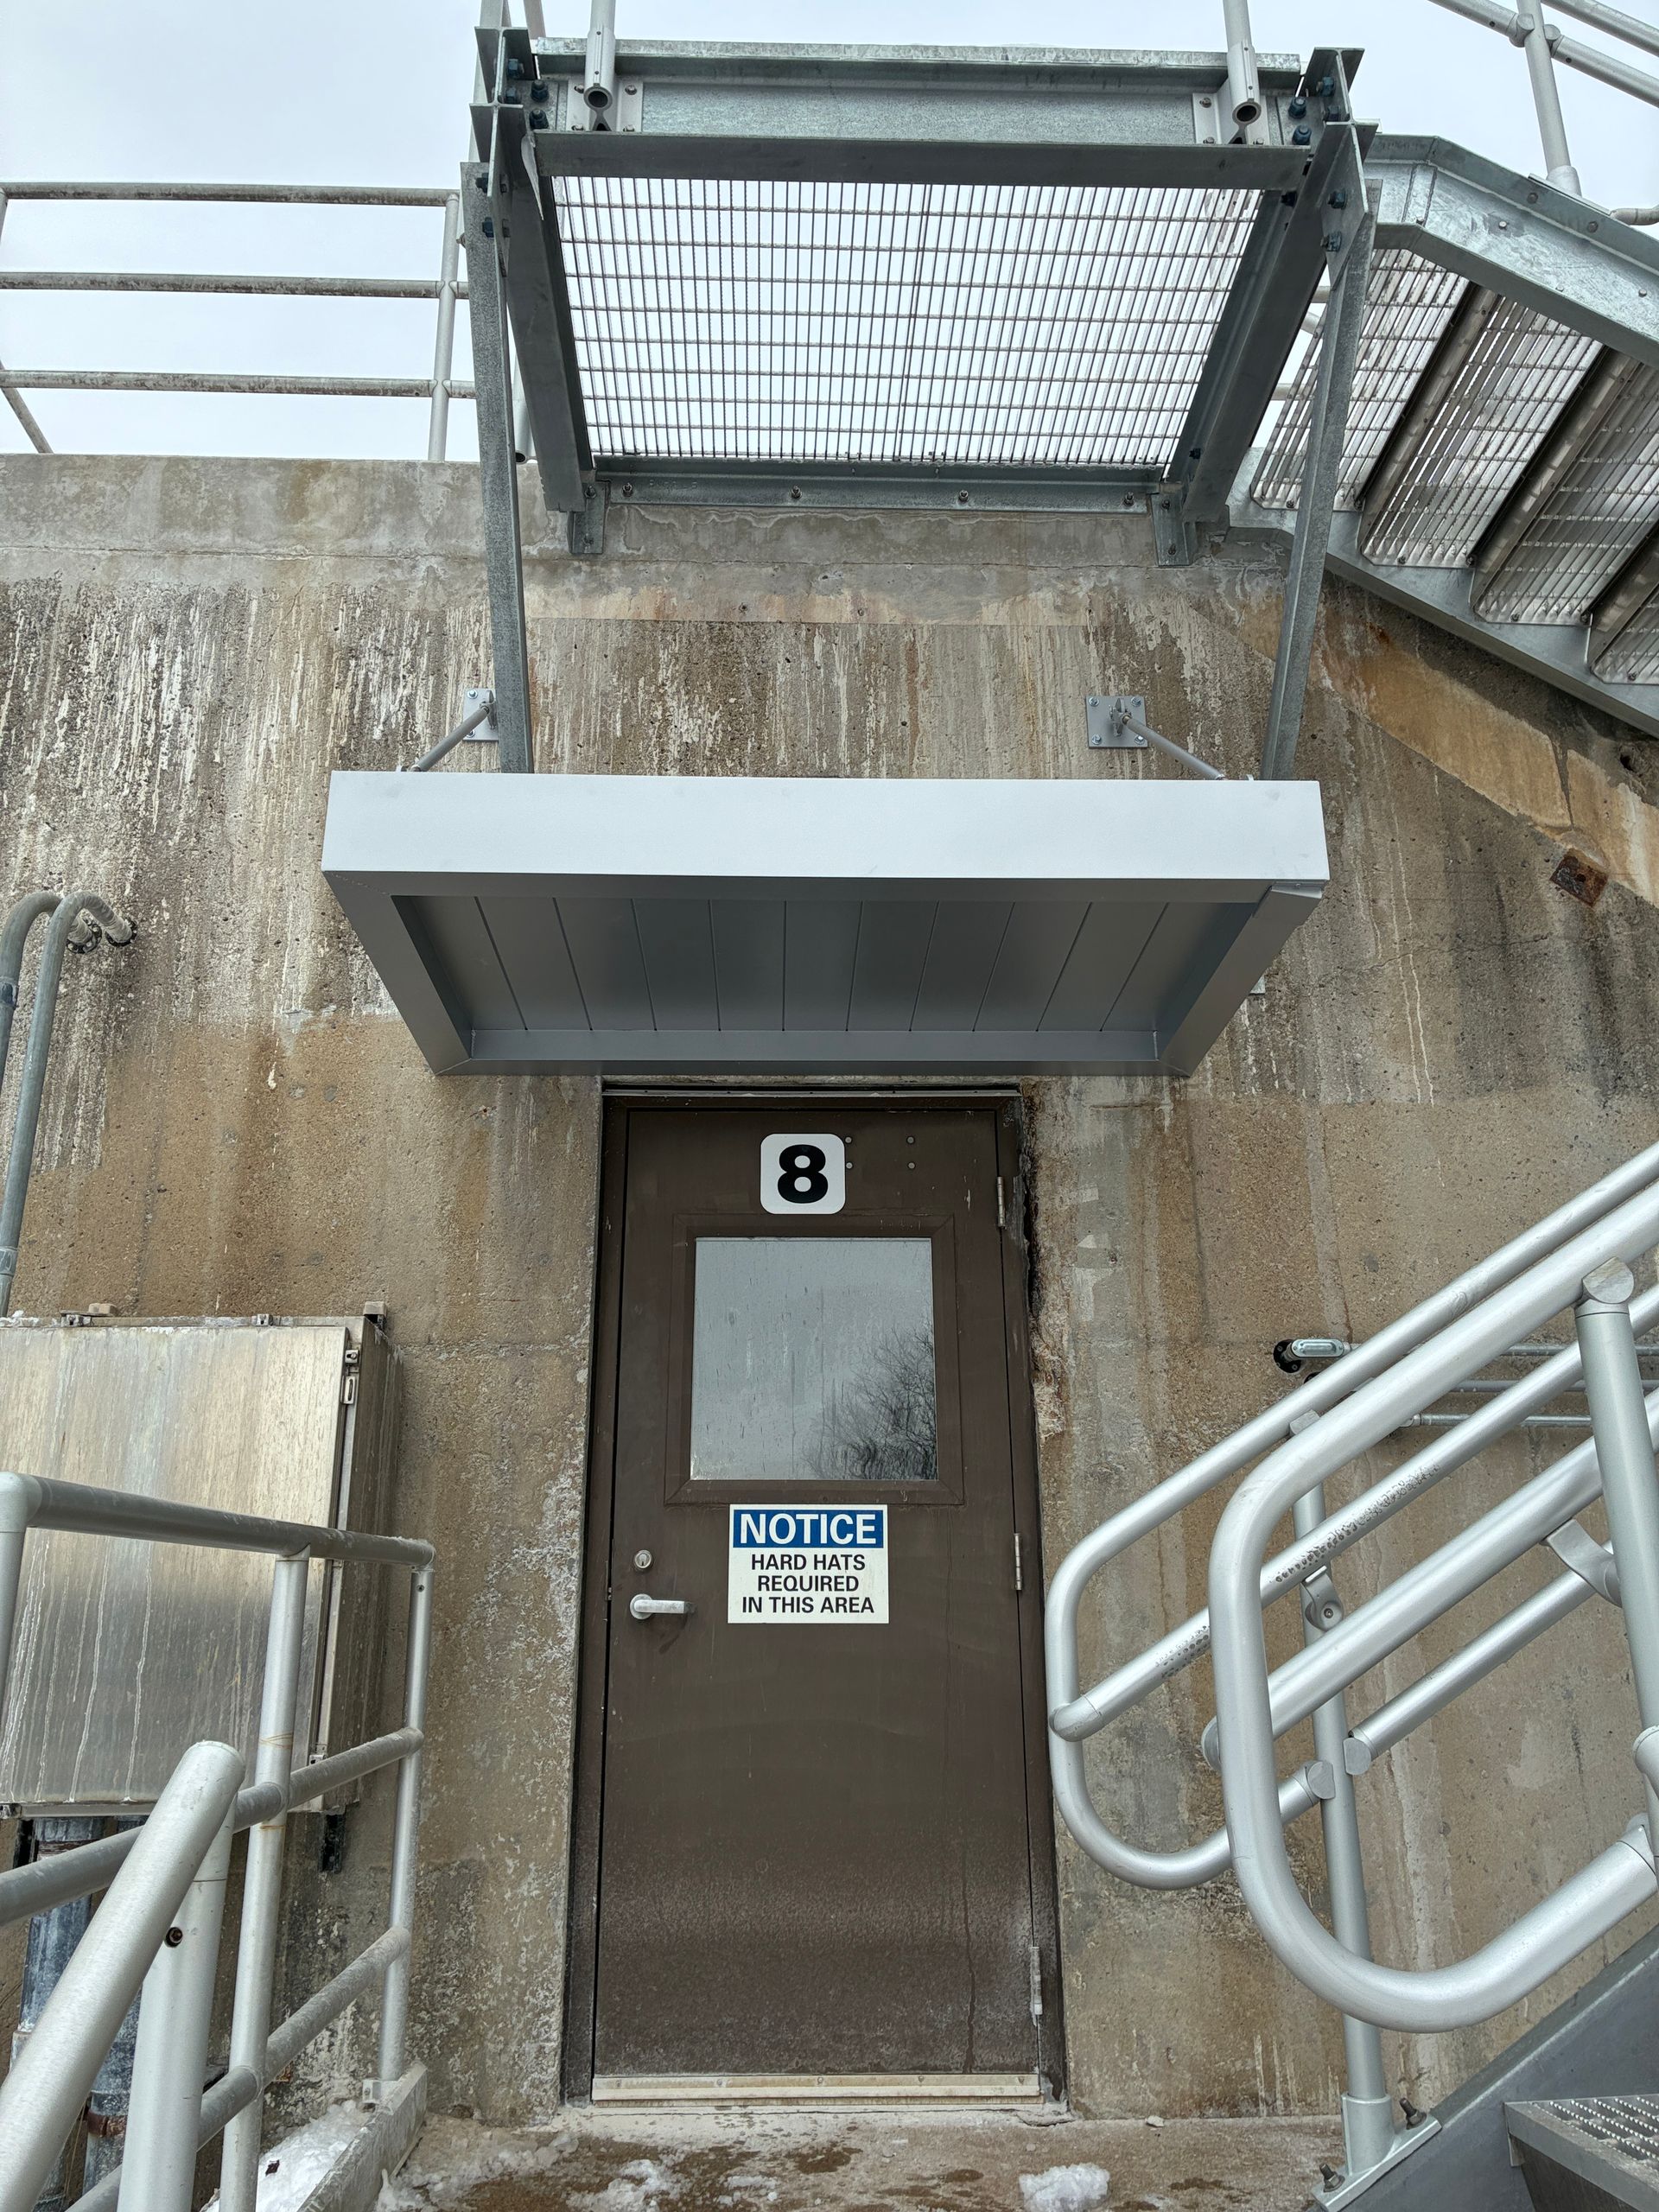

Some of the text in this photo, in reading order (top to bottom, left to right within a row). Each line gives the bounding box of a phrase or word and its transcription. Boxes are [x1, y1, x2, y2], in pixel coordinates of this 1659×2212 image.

[778, 1144, 829, 1204] 8
[741, 1513, 876, 1544] NOTICE
[751, 1554, 866, 1571] HARD HATS
[758, 1575, 859, 1592] REQUIRED
[742, 1597, 874, 1613] IN THIS AREA
